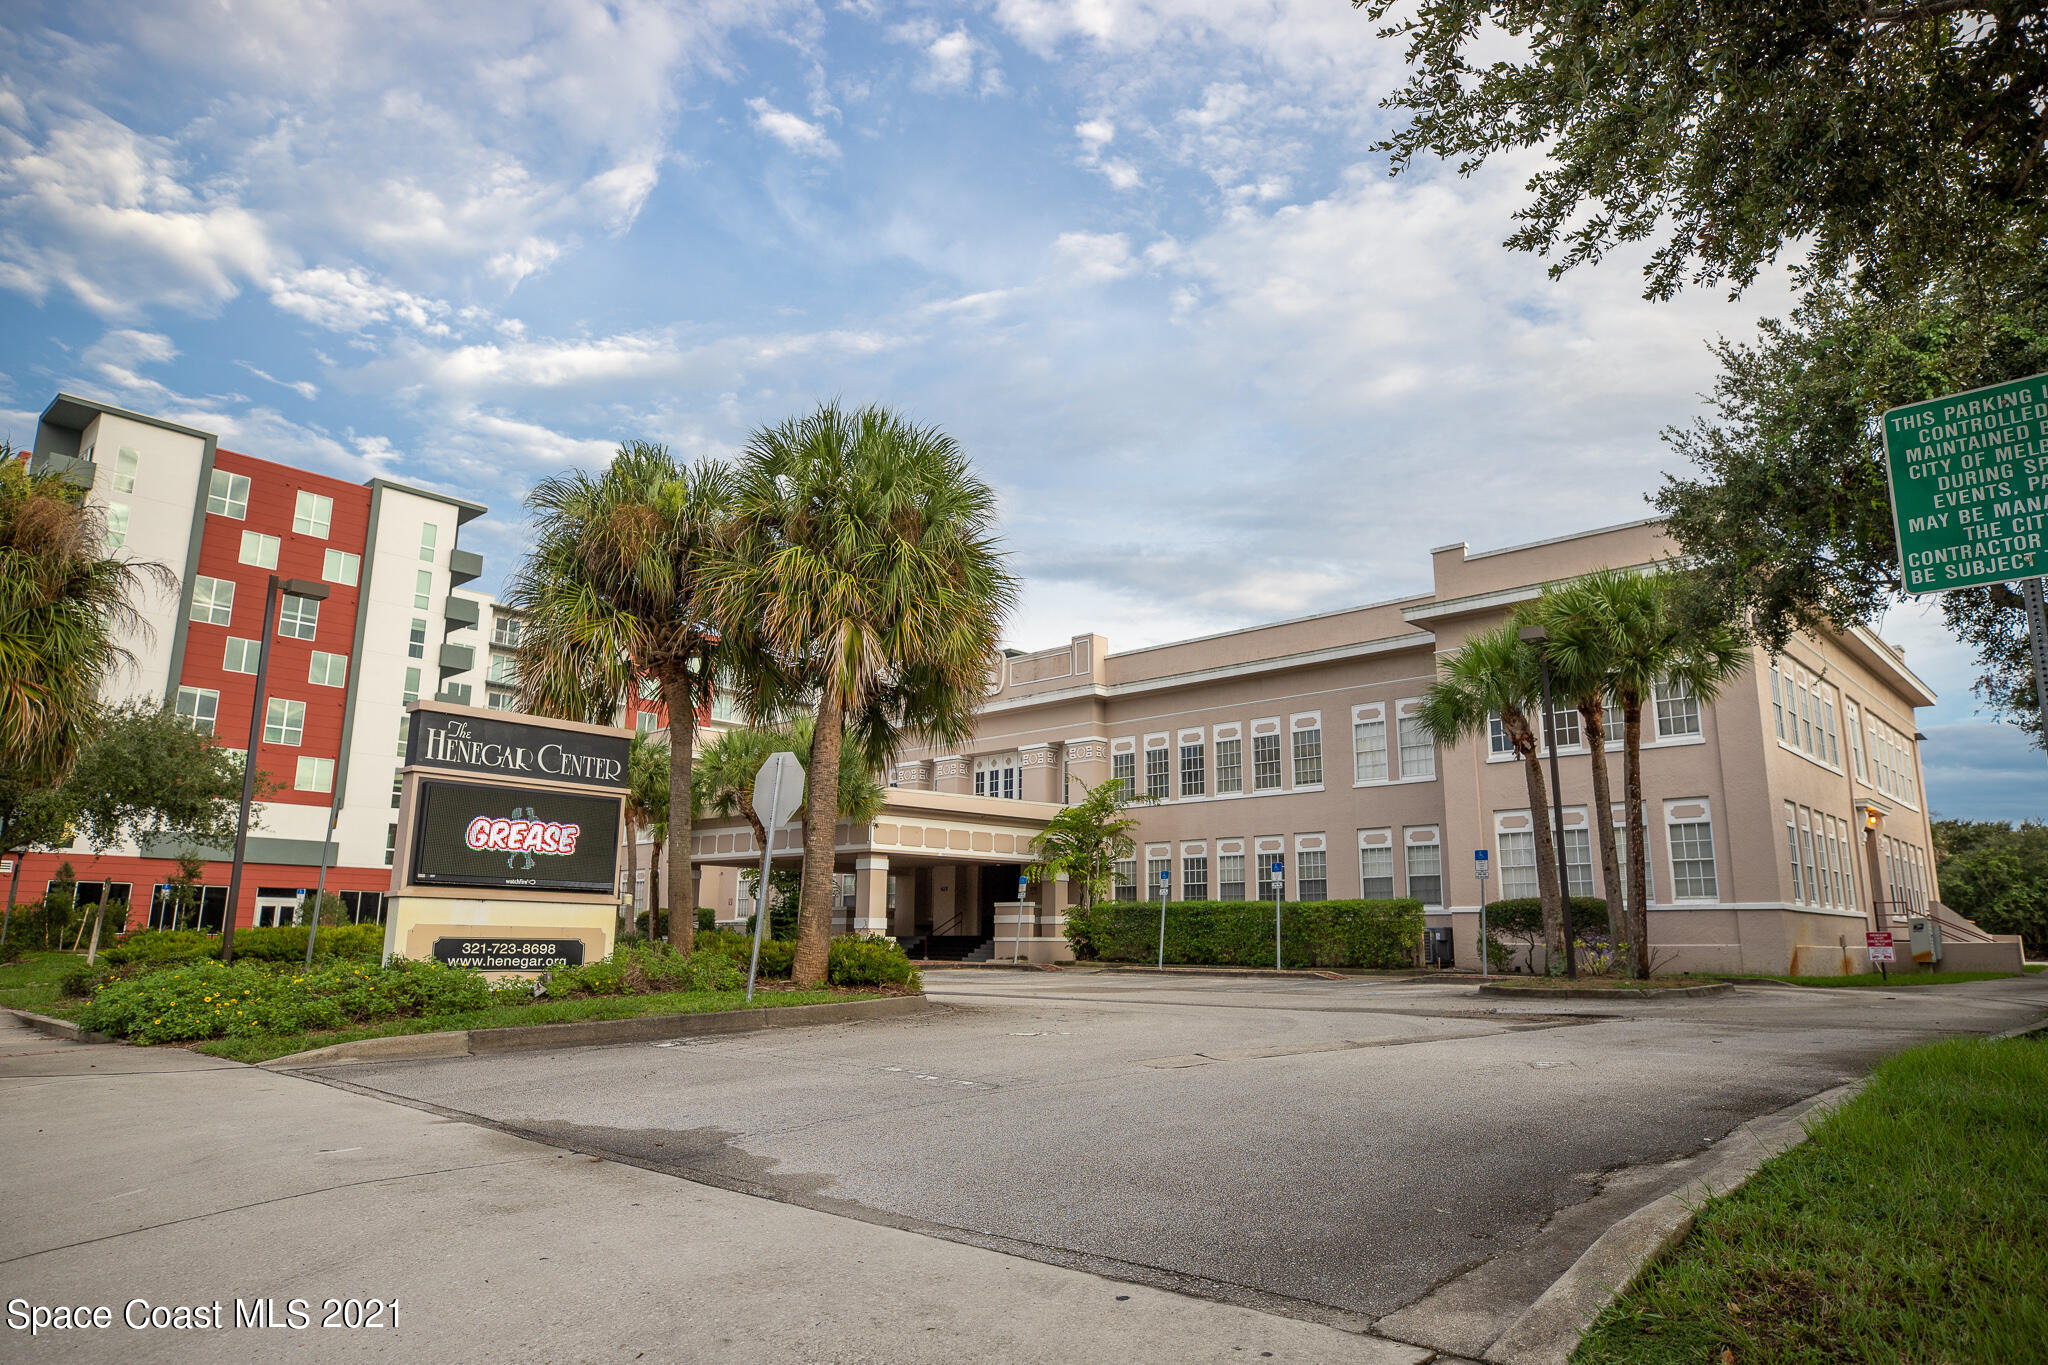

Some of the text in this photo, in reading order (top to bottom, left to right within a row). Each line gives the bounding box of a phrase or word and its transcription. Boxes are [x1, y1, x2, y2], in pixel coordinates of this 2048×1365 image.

[1891, 411, 1935, 432] THIS
[1944, 389, 2032, 421] PARKING
[1919, 403, 2048, 443] CONTROLLED
[1906, 425, 2029, 463] MAINTAINED
[1909, 459, 1950, 480] CITY
[1961, 452, 1985, 470] OF
[1938, 464, 2014, 491] DURING
[1934, 482, 2018, 509] EVENTS.
[1908, 513, 1949, 533] MAY
[1958, 507, 1985, 524] BE
[1963, 512, 2048, 541] THE CIT
[1908, 533, 2041, 568] CONTRACTOR
[1911, 552, 2037, 585] BE SUBJECT
[448, 720, 472, 739] The
[425, 727, 621, 782] HENEGAR CENTER
[466, 816, 580, 855] GREASE
[447, 956, 567, 969] www.henegar.org
[462, 943, 556, 954] 321-723-8698
